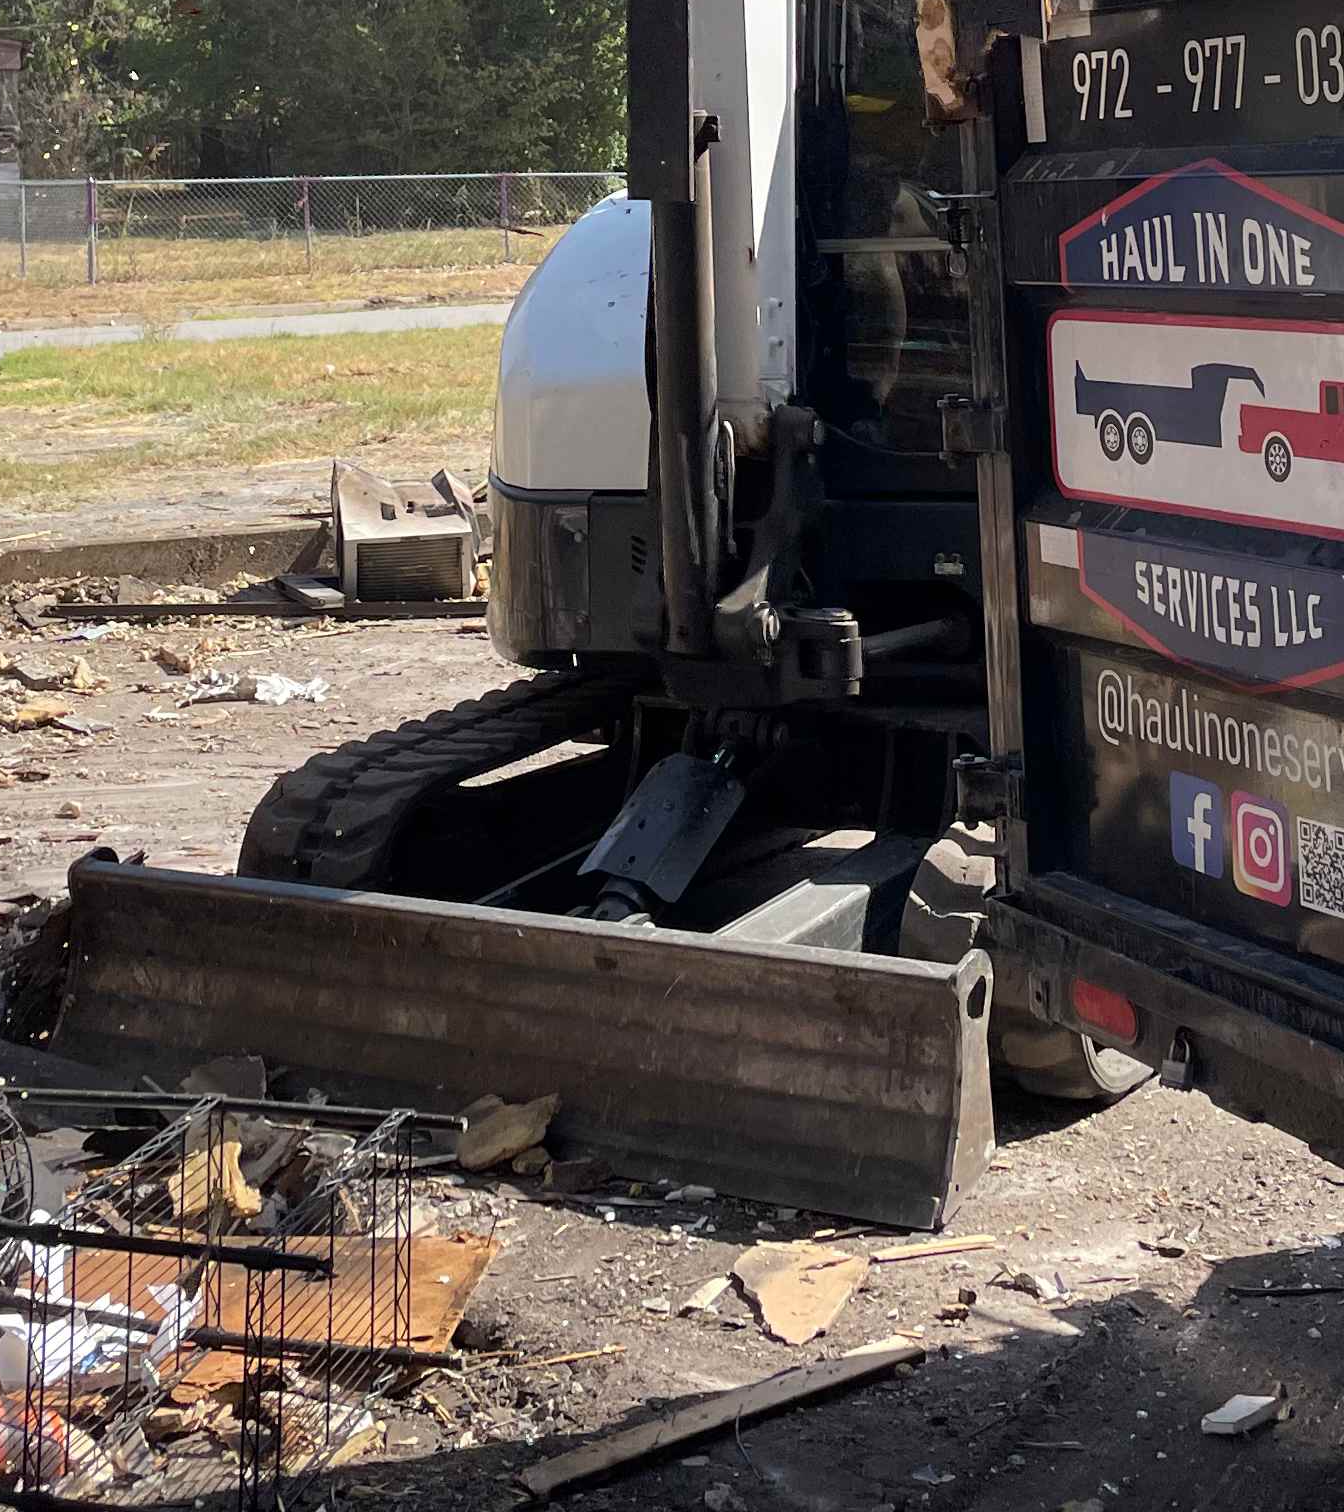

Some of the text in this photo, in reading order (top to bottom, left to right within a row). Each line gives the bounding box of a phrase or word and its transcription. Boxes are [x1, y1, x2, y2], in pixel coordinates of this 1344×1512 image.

[1099, 210, 1316, 287] HAUL IN ONE
[1133, 559, 1323, 648] SERVICES LLC
